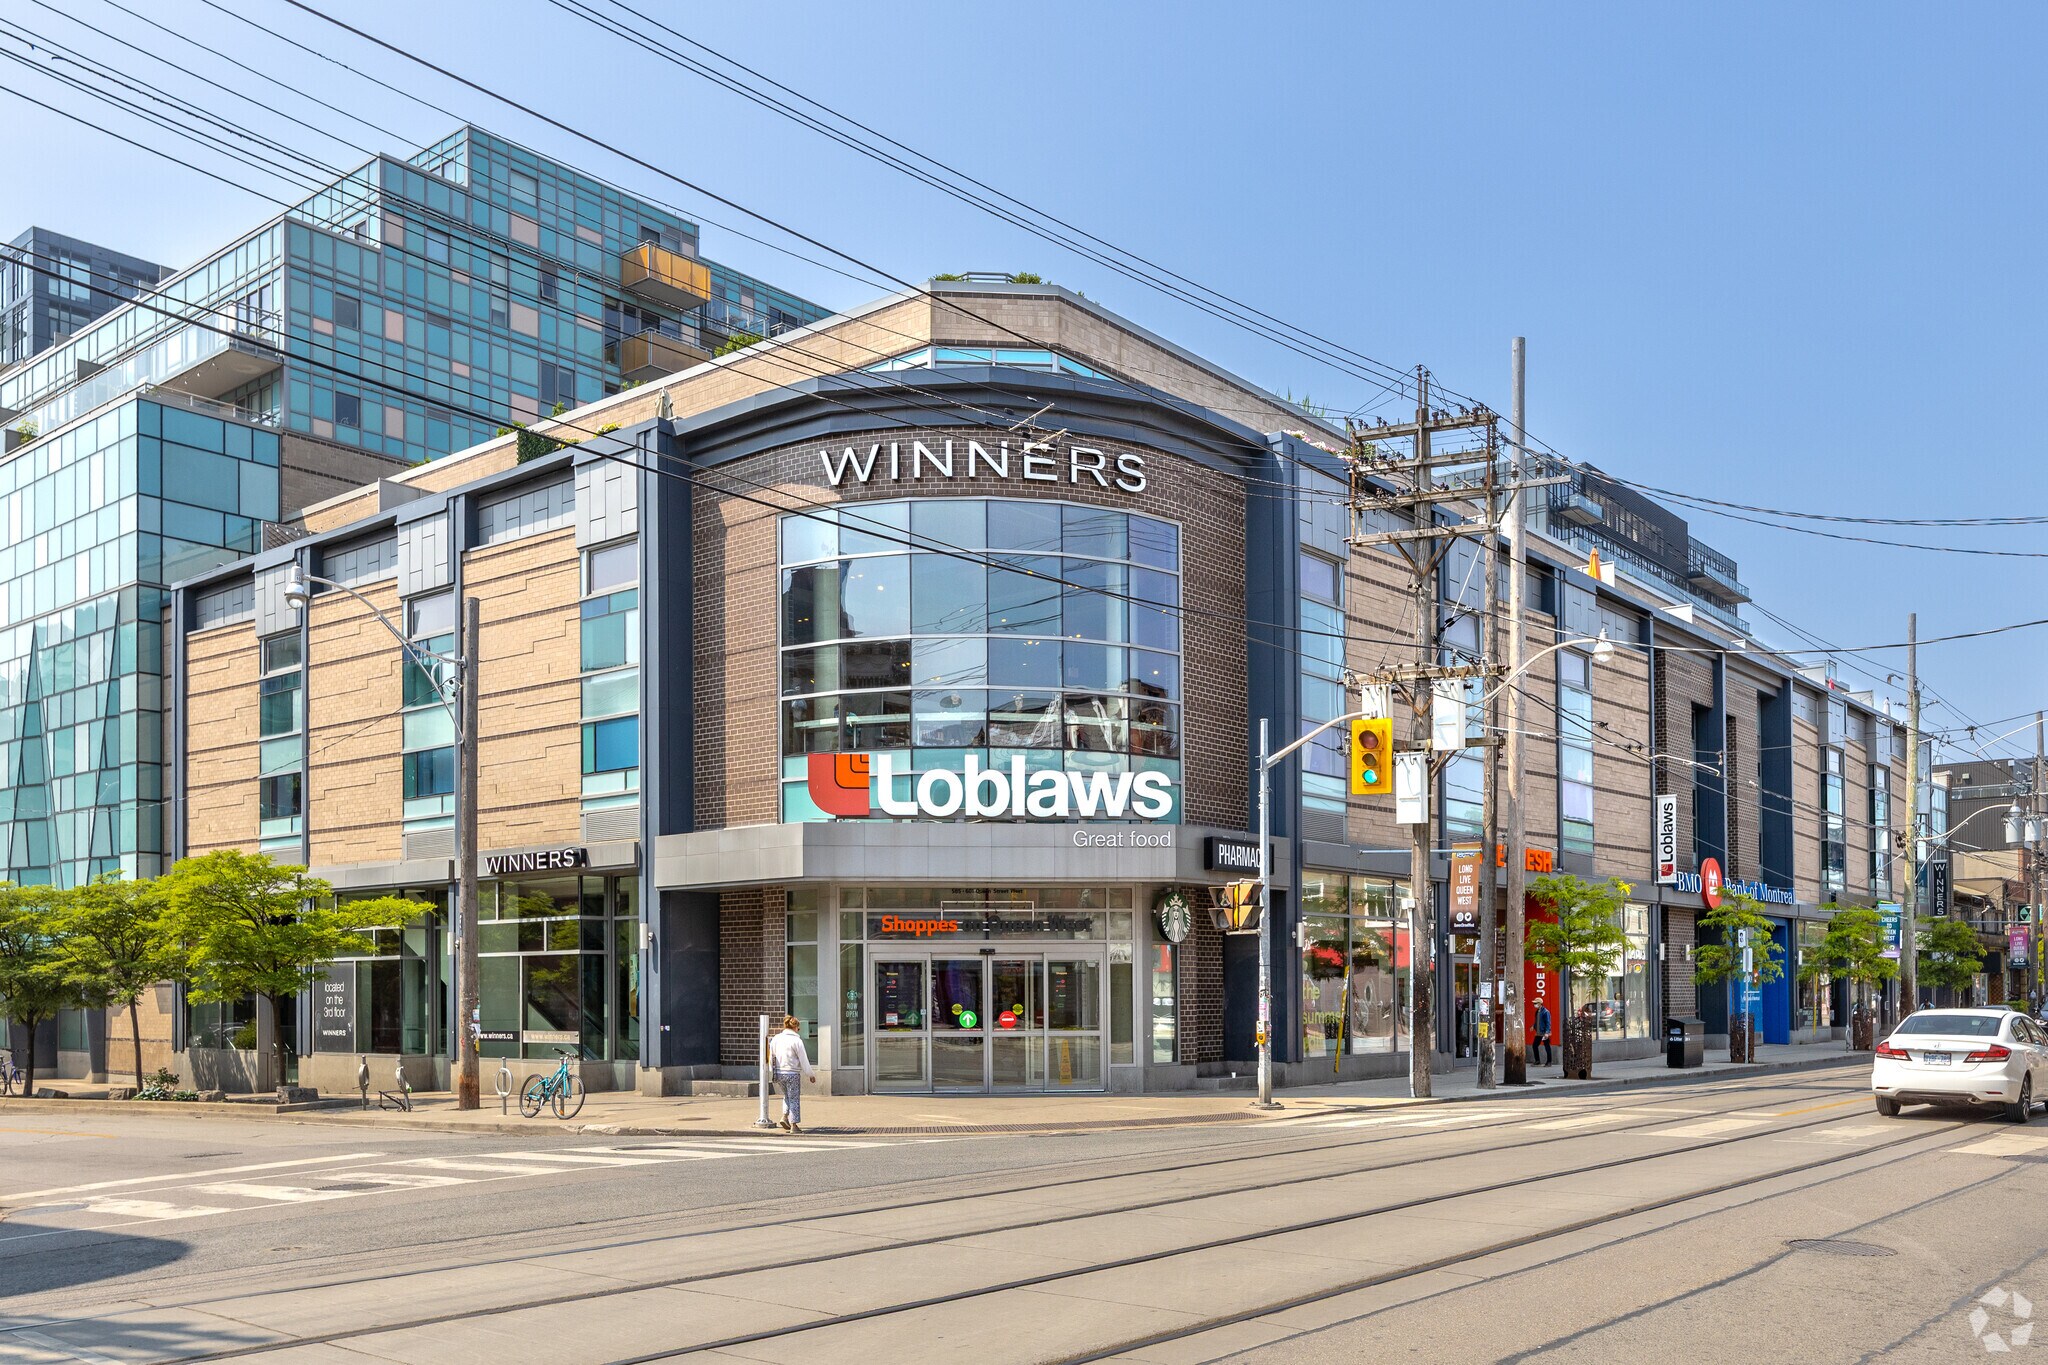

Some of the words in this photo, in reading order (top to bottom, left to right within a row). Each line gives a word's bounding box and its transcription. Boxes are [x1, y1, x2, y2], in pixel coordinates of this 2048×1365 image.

[820, 440, 1147, 493] WINNERS
[877, 754, 1173, 818] Loblaws
[1073, 830, 1124, 848] Great
[1129, 830, 1171, 847] food
[1661, 802, 1674, 863] Loblaws
[484, 849, 575, 874] WINNERS
[1218, 844, 1261, 868] PHARMAC
[1458, 864, 1473, 874] LONG
[1459, 875, 1471, 884] LIVE
[1678, 871, 1703, 894] BMO
[1724, 877, 1750, 897] Bank
[1750, 884, 1759, 900] of
[1760, 884, 1796, 905] Montreal
[1934, 864, 1946, 915] WINNERS
[1456, 885, 1474, 895] QUEEN
[1457, 896, 1473, 905] WEST
[881, 914, 958, 937] Shoppes
[962, 921, 985, 933] on
[988, 915, 1044, 934] Queen
[1047, 914, 1093, 932] West
[325, 981, 344, 992] located
[1536, 973, 1546, 997] JOE
[325, 996, 333, 1005] on
[334, 995, 344, 1005] the
[323, 1007, 333, 1018] 3rd
[334, 1006, 346, 1018] floor
[845, 1010, 859, 1018] OPEN
